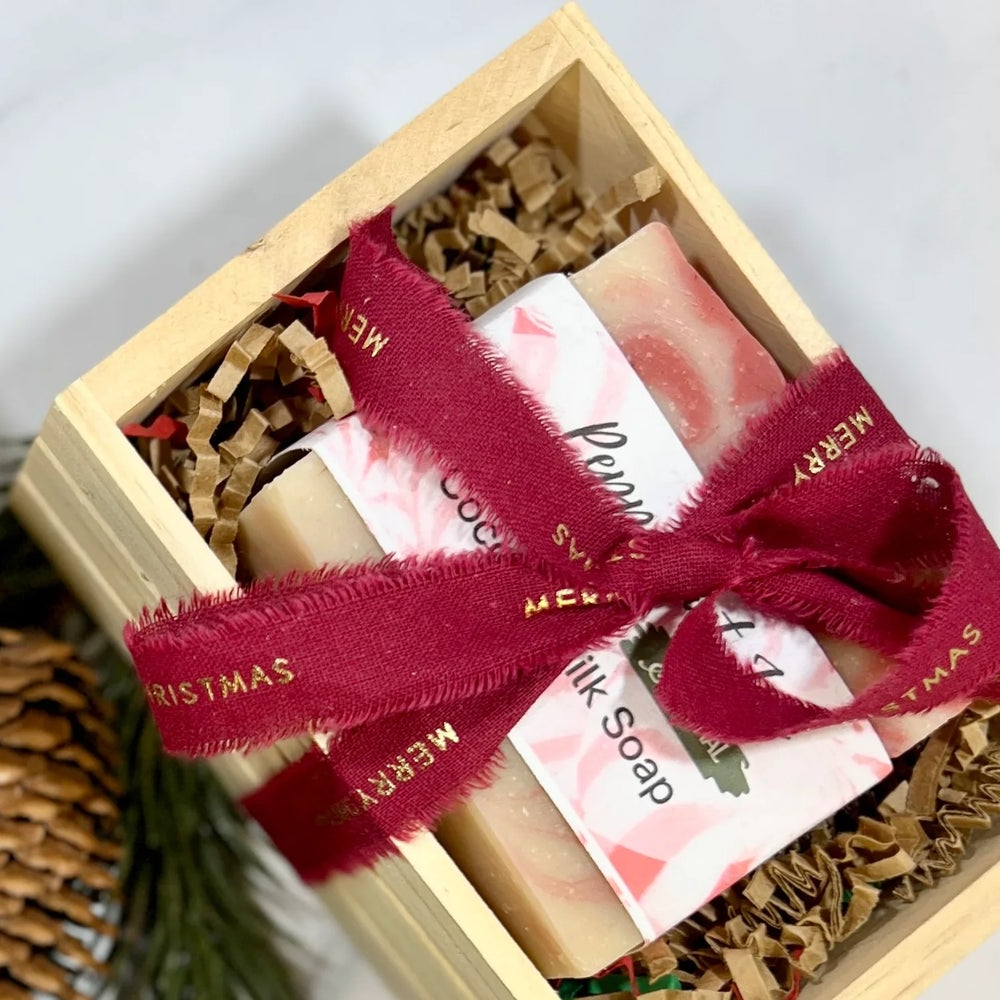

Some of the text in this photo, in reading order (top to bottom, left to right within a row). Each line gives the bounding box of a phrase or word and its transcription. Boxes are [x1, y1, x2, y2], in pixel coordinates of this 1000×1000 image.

[793, 405, 875, 487] MERRY
[145, 657, 295, 707] RISTMAS
[355, 721, 460, 811] MERRY
[601, 706, 674, 805] Soap
